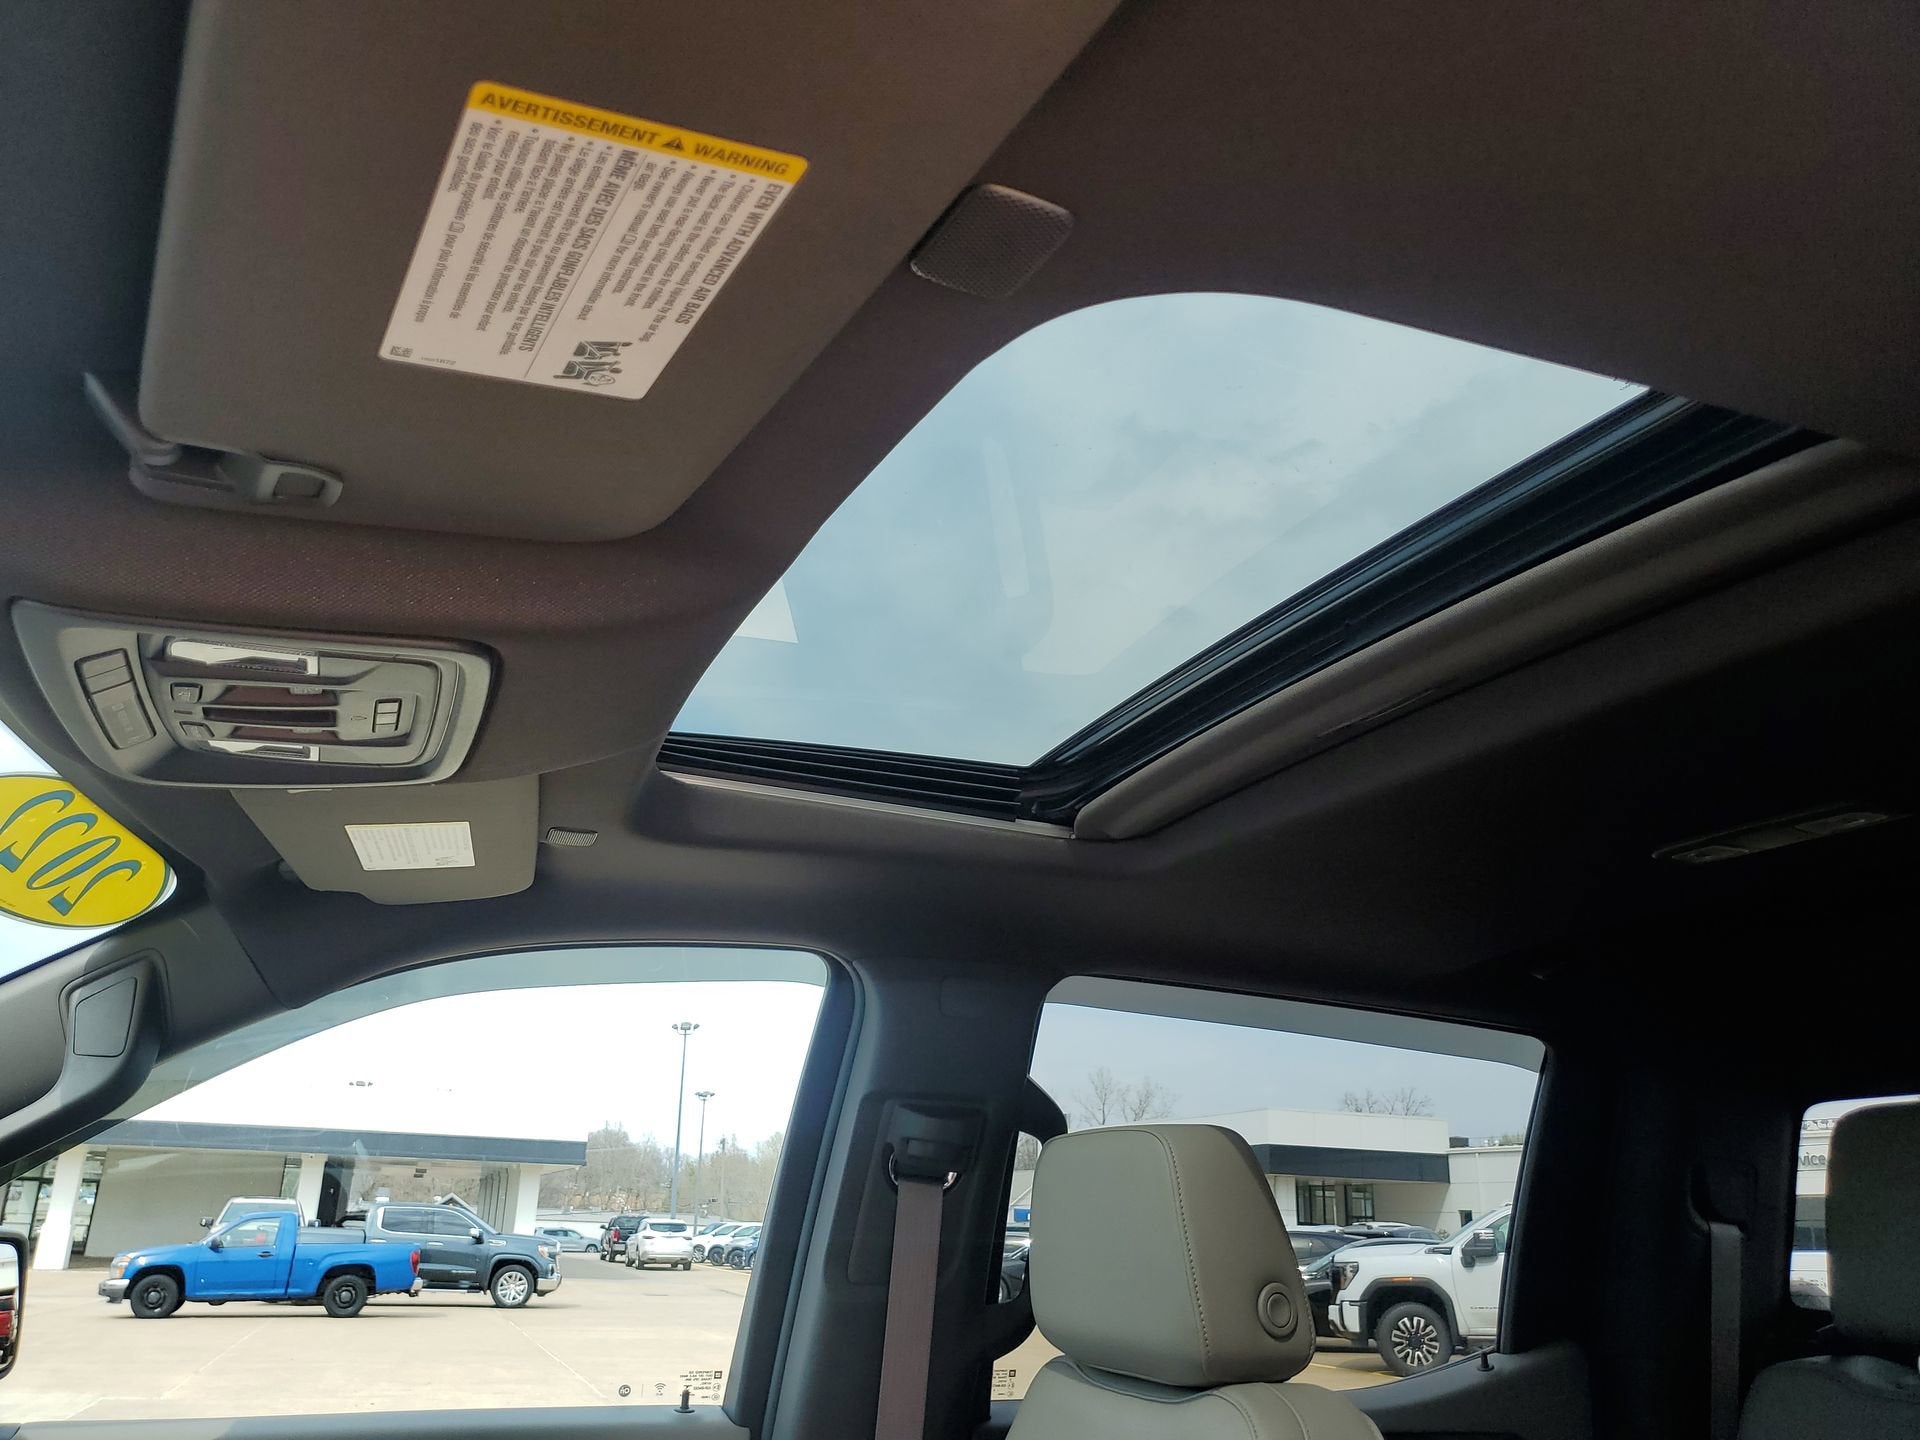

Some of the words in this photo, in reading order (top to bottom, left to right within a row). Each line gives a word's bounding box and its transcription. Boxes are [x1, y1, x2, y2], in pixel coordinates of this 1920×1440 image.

[479, 92, 661, 147] AVERTISSEMENT
[693, 141, 792, 177] WARNING
[608, 149, 643, 182] MÊME
[594, 180, 622, 207] AVEC
[752, 182, 784, 210] EVEN
[583, 206, 608, 227] DES
[734, 210, 765, 237] WITH
[570, 226, 597, 251] SACS
[700, 237, 747, 286] ADVANCED
[543, 250, 584, 302] GONFLABLES
[690, 285, 713, 301] AIR
[673, 301, 701, 325] BAGS
[517, 302, 557, 353] INTELLIGENTS
[1798, 1151, 1826, 1166] vice
